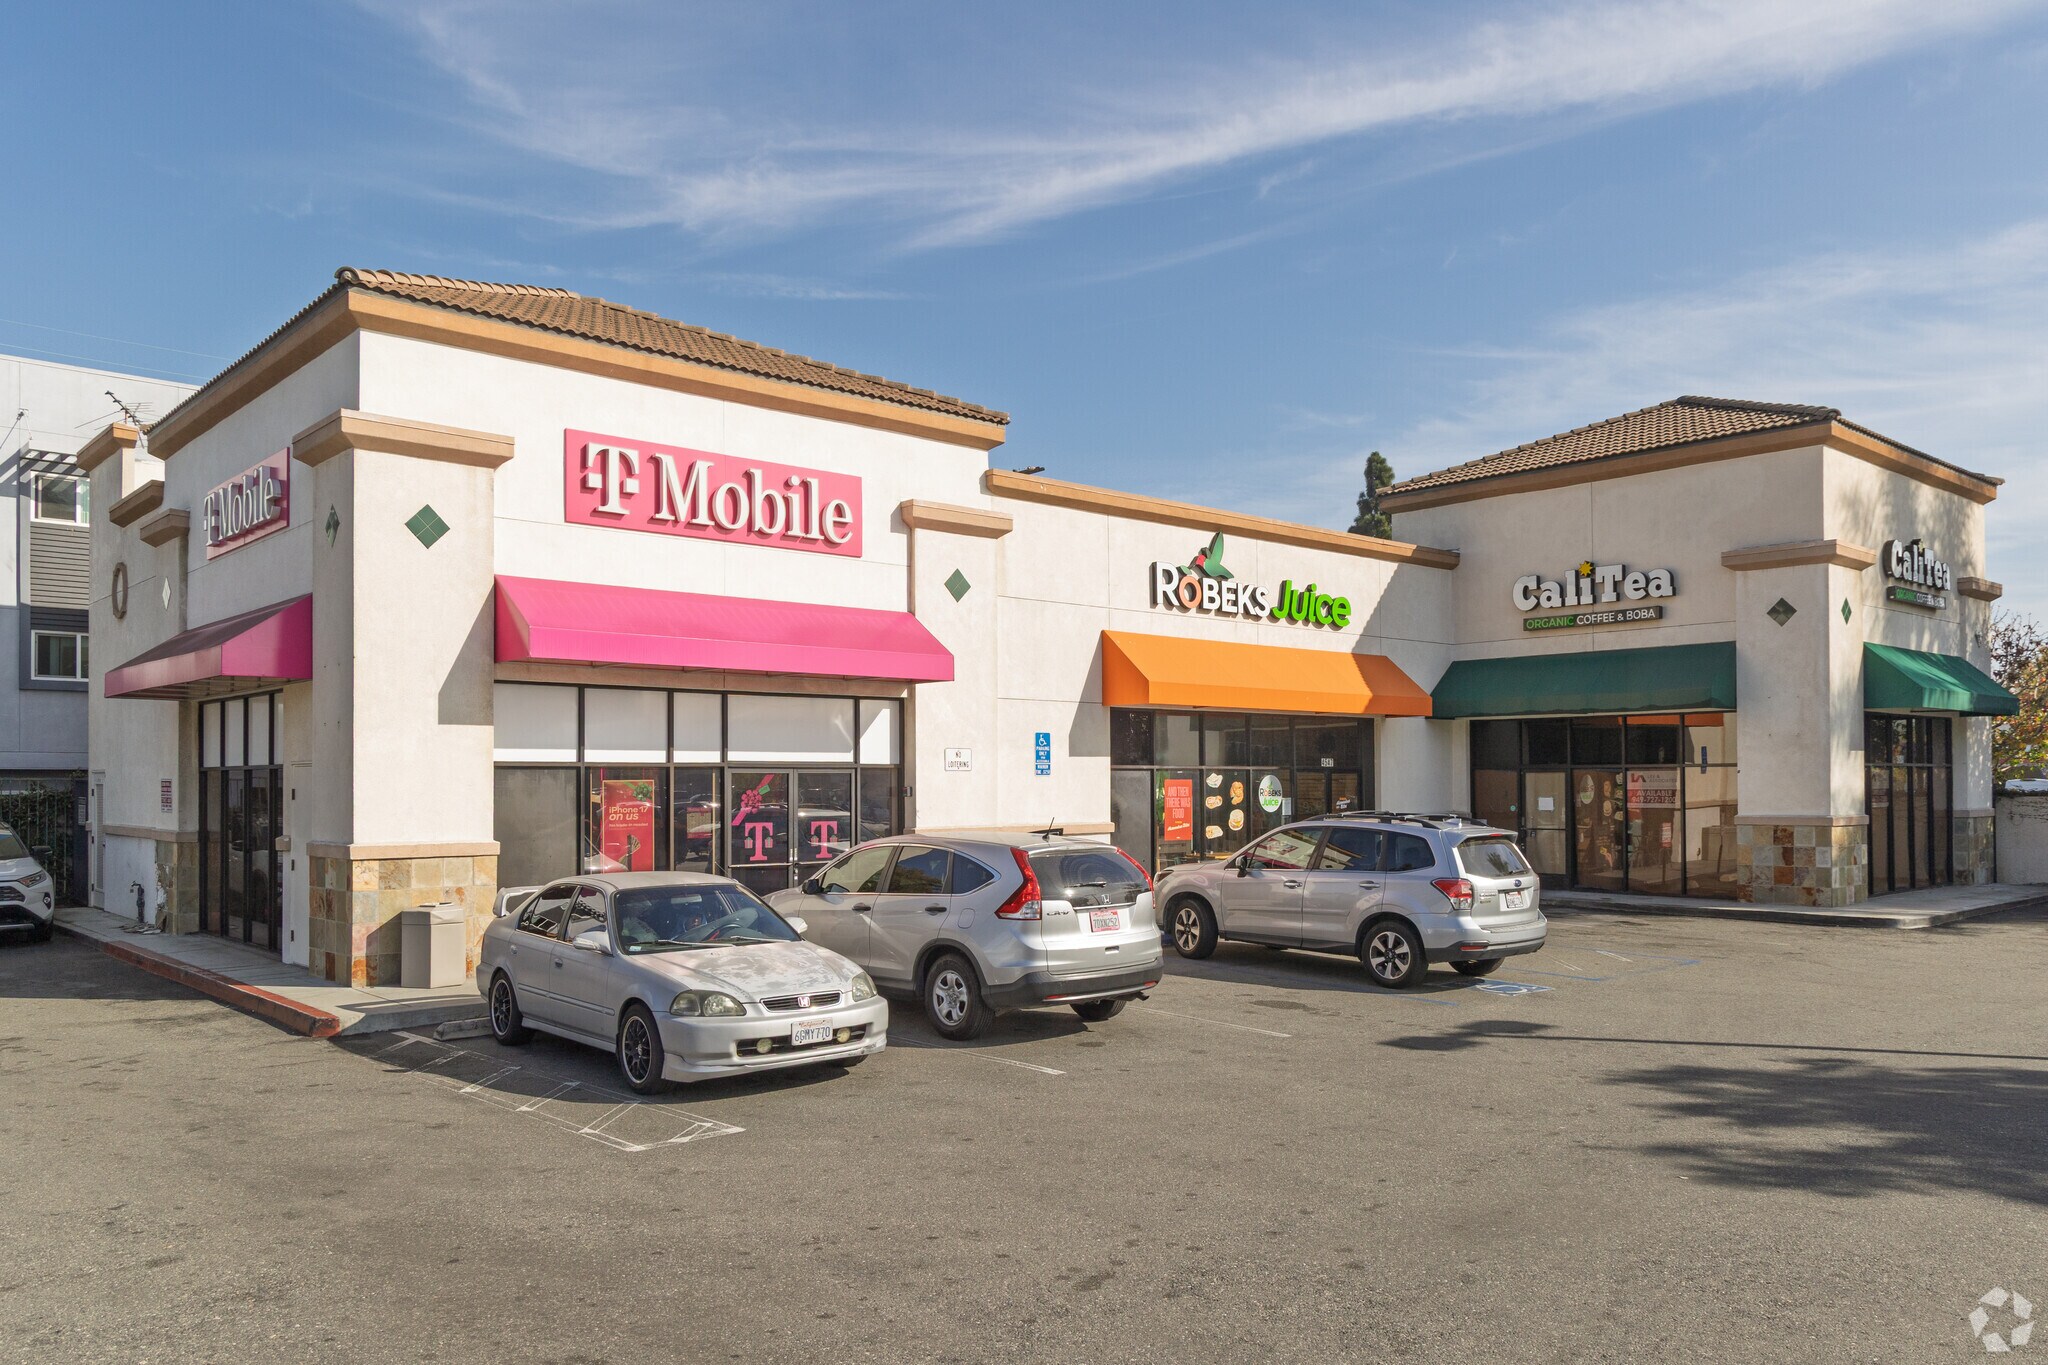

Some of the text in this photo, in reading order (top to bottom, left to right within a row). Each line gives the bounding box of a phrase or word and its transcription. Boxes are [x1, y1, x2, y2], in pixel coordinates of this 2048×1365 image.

[219, 465, 275, 541] Mobile
[651, 452, 854, 544] Mobile
[1156, 561, 1352, 628] ROBEKS Juice
[1526, 608, 1656, 630] ORGANIC COFFEE & BOBA
[947, 760, 970, 769] LOITERING
[1167, 786, 1190, 797] AND THEN
[1635, 789, 1673, 797] AVAILABLE
[1165, 797, 1181, 808] THERE
[1262, 797, 1279, 807] Juice
[608, 805, 649, 814] iPhone 17
[1172, 808, 1185, 819] FOOD
[608, 813, 639, 821] on us
[744, 822, 774, 861] T
[810, 821, 838, 859] T
[794, 1026, 831, 1041] 6GMY770
